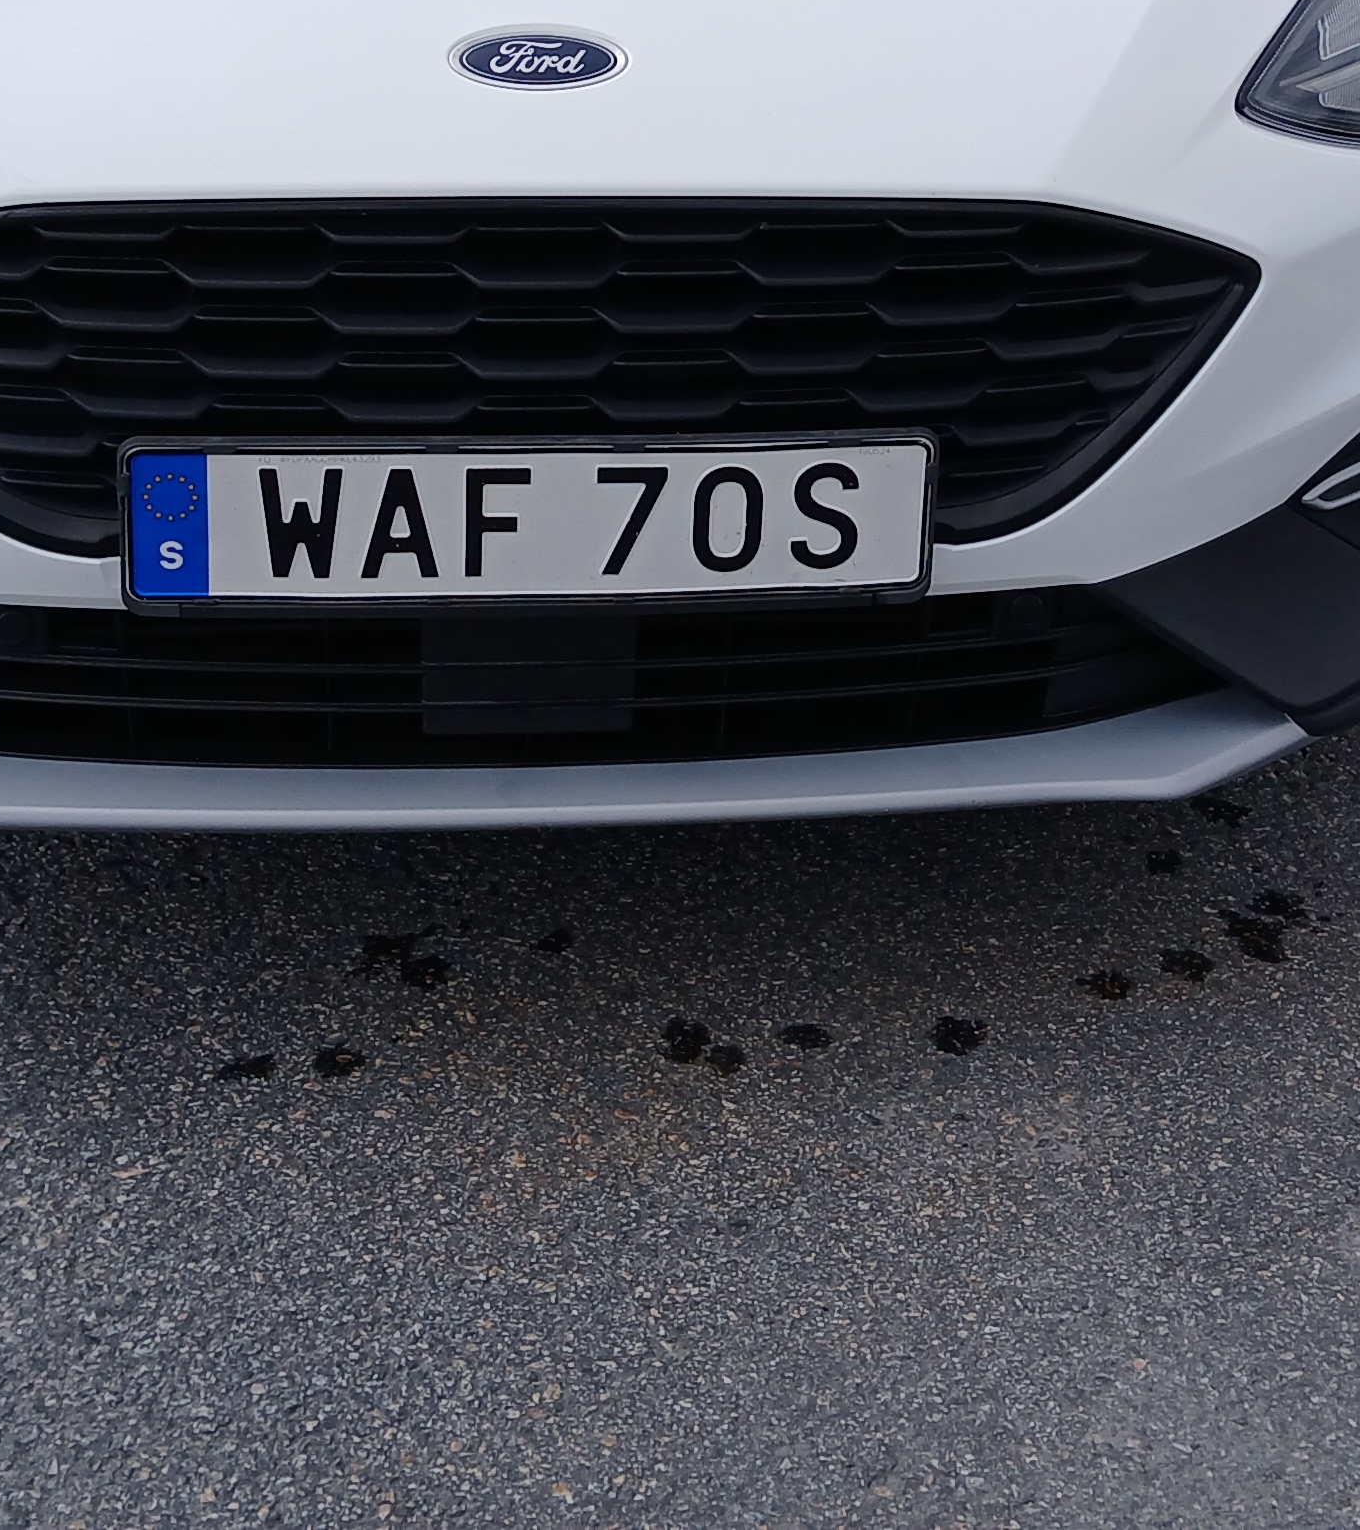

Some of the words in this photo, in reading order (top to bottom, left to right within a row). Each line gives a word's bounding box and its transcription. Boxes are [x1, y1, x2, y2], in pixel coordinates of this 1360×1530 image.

[489, 40, 587, 74] Ford
[159, 540, 184, 570] S
[258, 466, 533, 579] WAF
[596, 461, 860, 576] 70S
